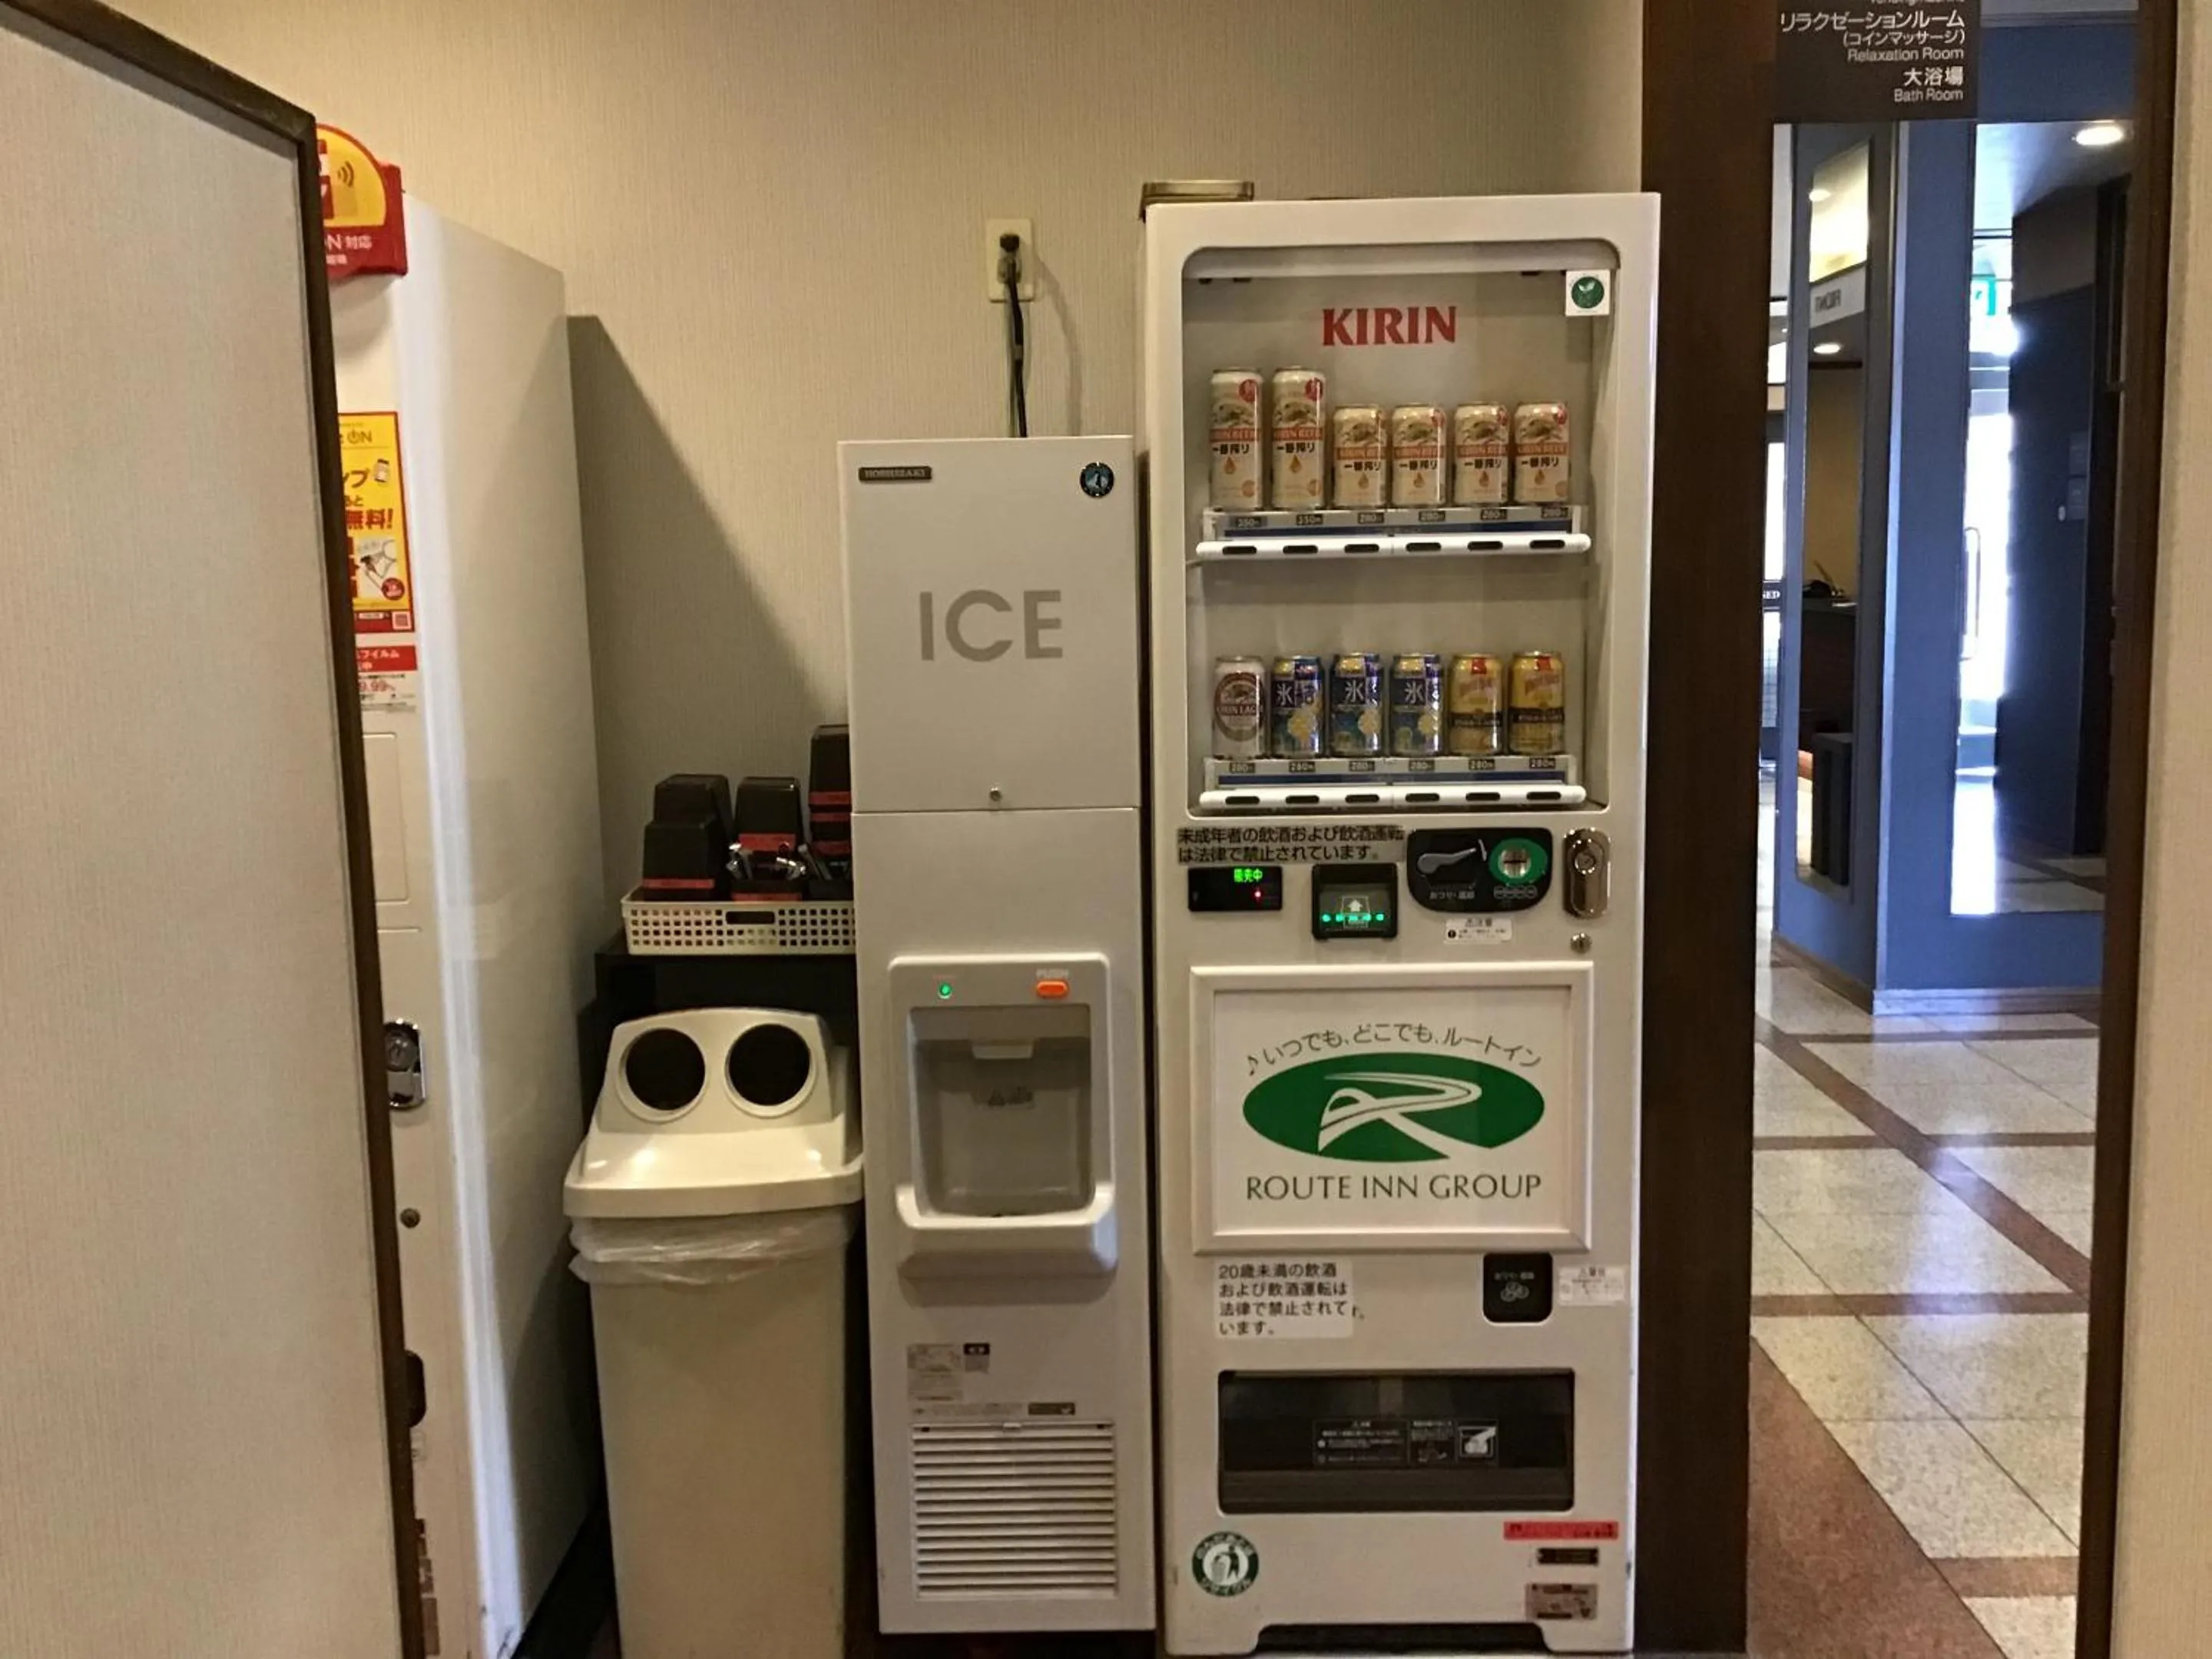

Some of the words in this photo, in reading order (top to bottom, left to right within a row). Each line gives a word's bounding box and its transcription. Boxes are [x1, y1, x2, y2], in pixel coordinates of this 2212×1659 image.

[1780, 9, 1965, 32] リラクゼーションルーム
[1846, 48, 1919, 62] Relaxation
[1922, 46, 1965, 61] Room
[1903, 66, 1964, 86] 大浴場
[1893, 88, 1923, 103] Bath
[1926, 88, 1964, 101] Room
[1322, 306, 1457, 346] KIRIN
[919, 588, 1063, 662] ICE
[1247, 1175, 1351, 1200] ROUTE
[1363, 1175, 1418, 1199] INN
[1429, 1174, 1542, 1199] GROUP
